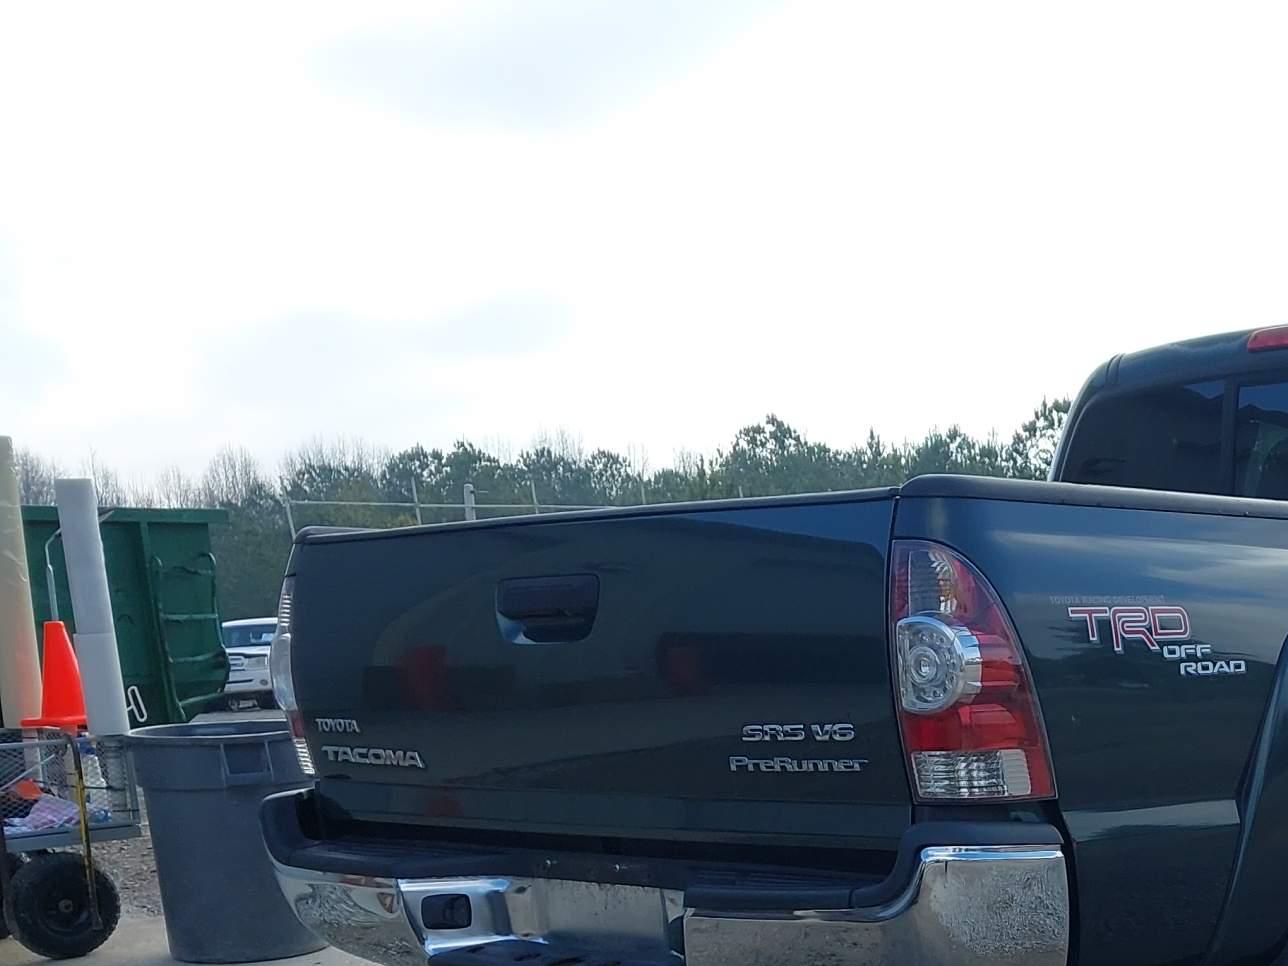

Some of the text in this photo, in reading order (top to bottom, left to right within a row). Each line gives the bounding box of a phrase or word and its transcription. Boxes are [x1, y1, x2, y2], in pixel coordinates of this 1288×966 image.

[1068, 606, 1190, 652] TRD
[1163, 644, 1212, 659] OFF
[1180, 660, 1247, 675] ROAD
[315, 718, 360, 733] TOYOTA
[742, 723, 855, 741] SR5 V6
[321, 745, 426, 768] TACOMA
[729, 756, 869, 772] PreRunner
